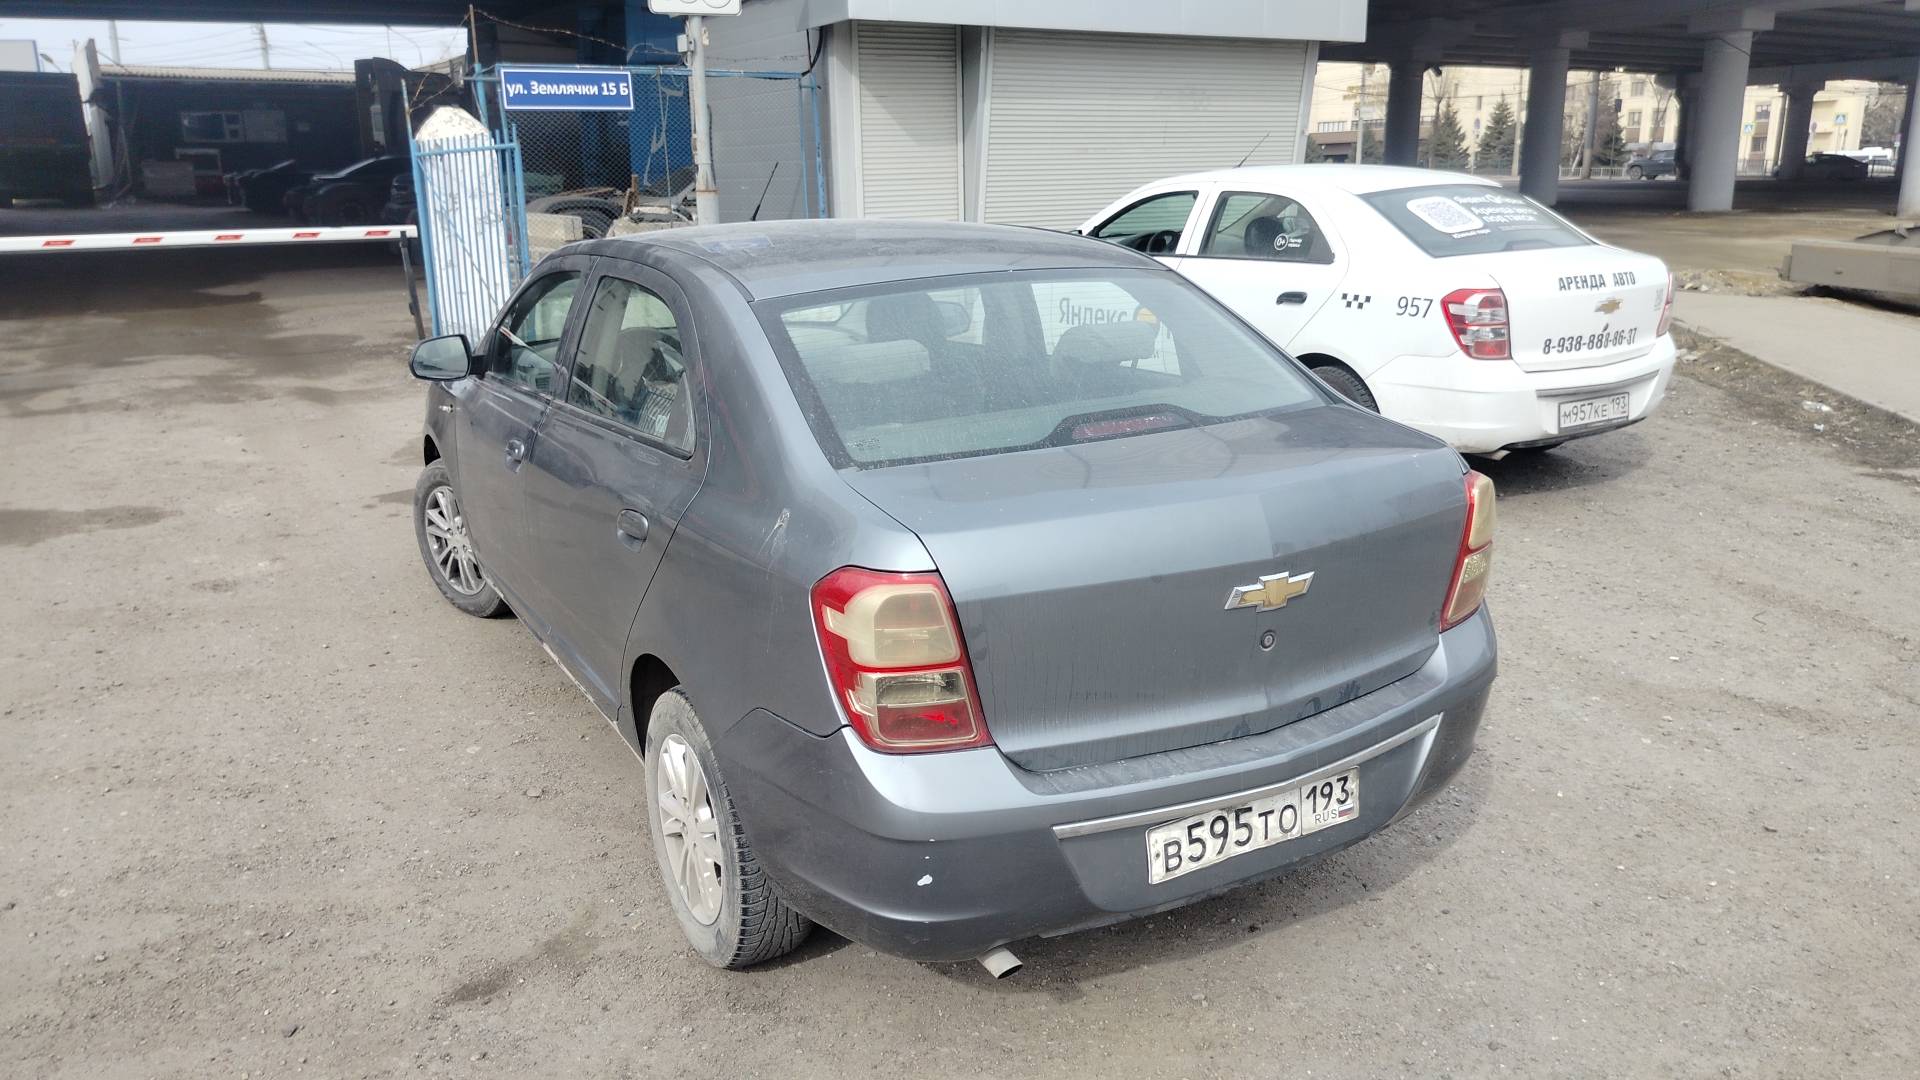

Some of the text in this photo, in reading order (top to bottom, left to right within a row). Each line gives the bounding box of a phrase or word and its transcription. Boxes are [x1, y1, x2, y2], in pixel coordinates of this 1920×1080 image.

[506, 81, 629, 97] ул. Землячки 15 Б
[1558, 271, 1636, 291] АРЕНДА АВТО
[1396, 296, 1434, 318] 957
[1542, 328, 1638, 355] 8-938-888-86-37
[1610, 395, 1627, 417] 193
[1305, 775, 1350, 814] 193
[1314, 809, 1338, 825] RUS
